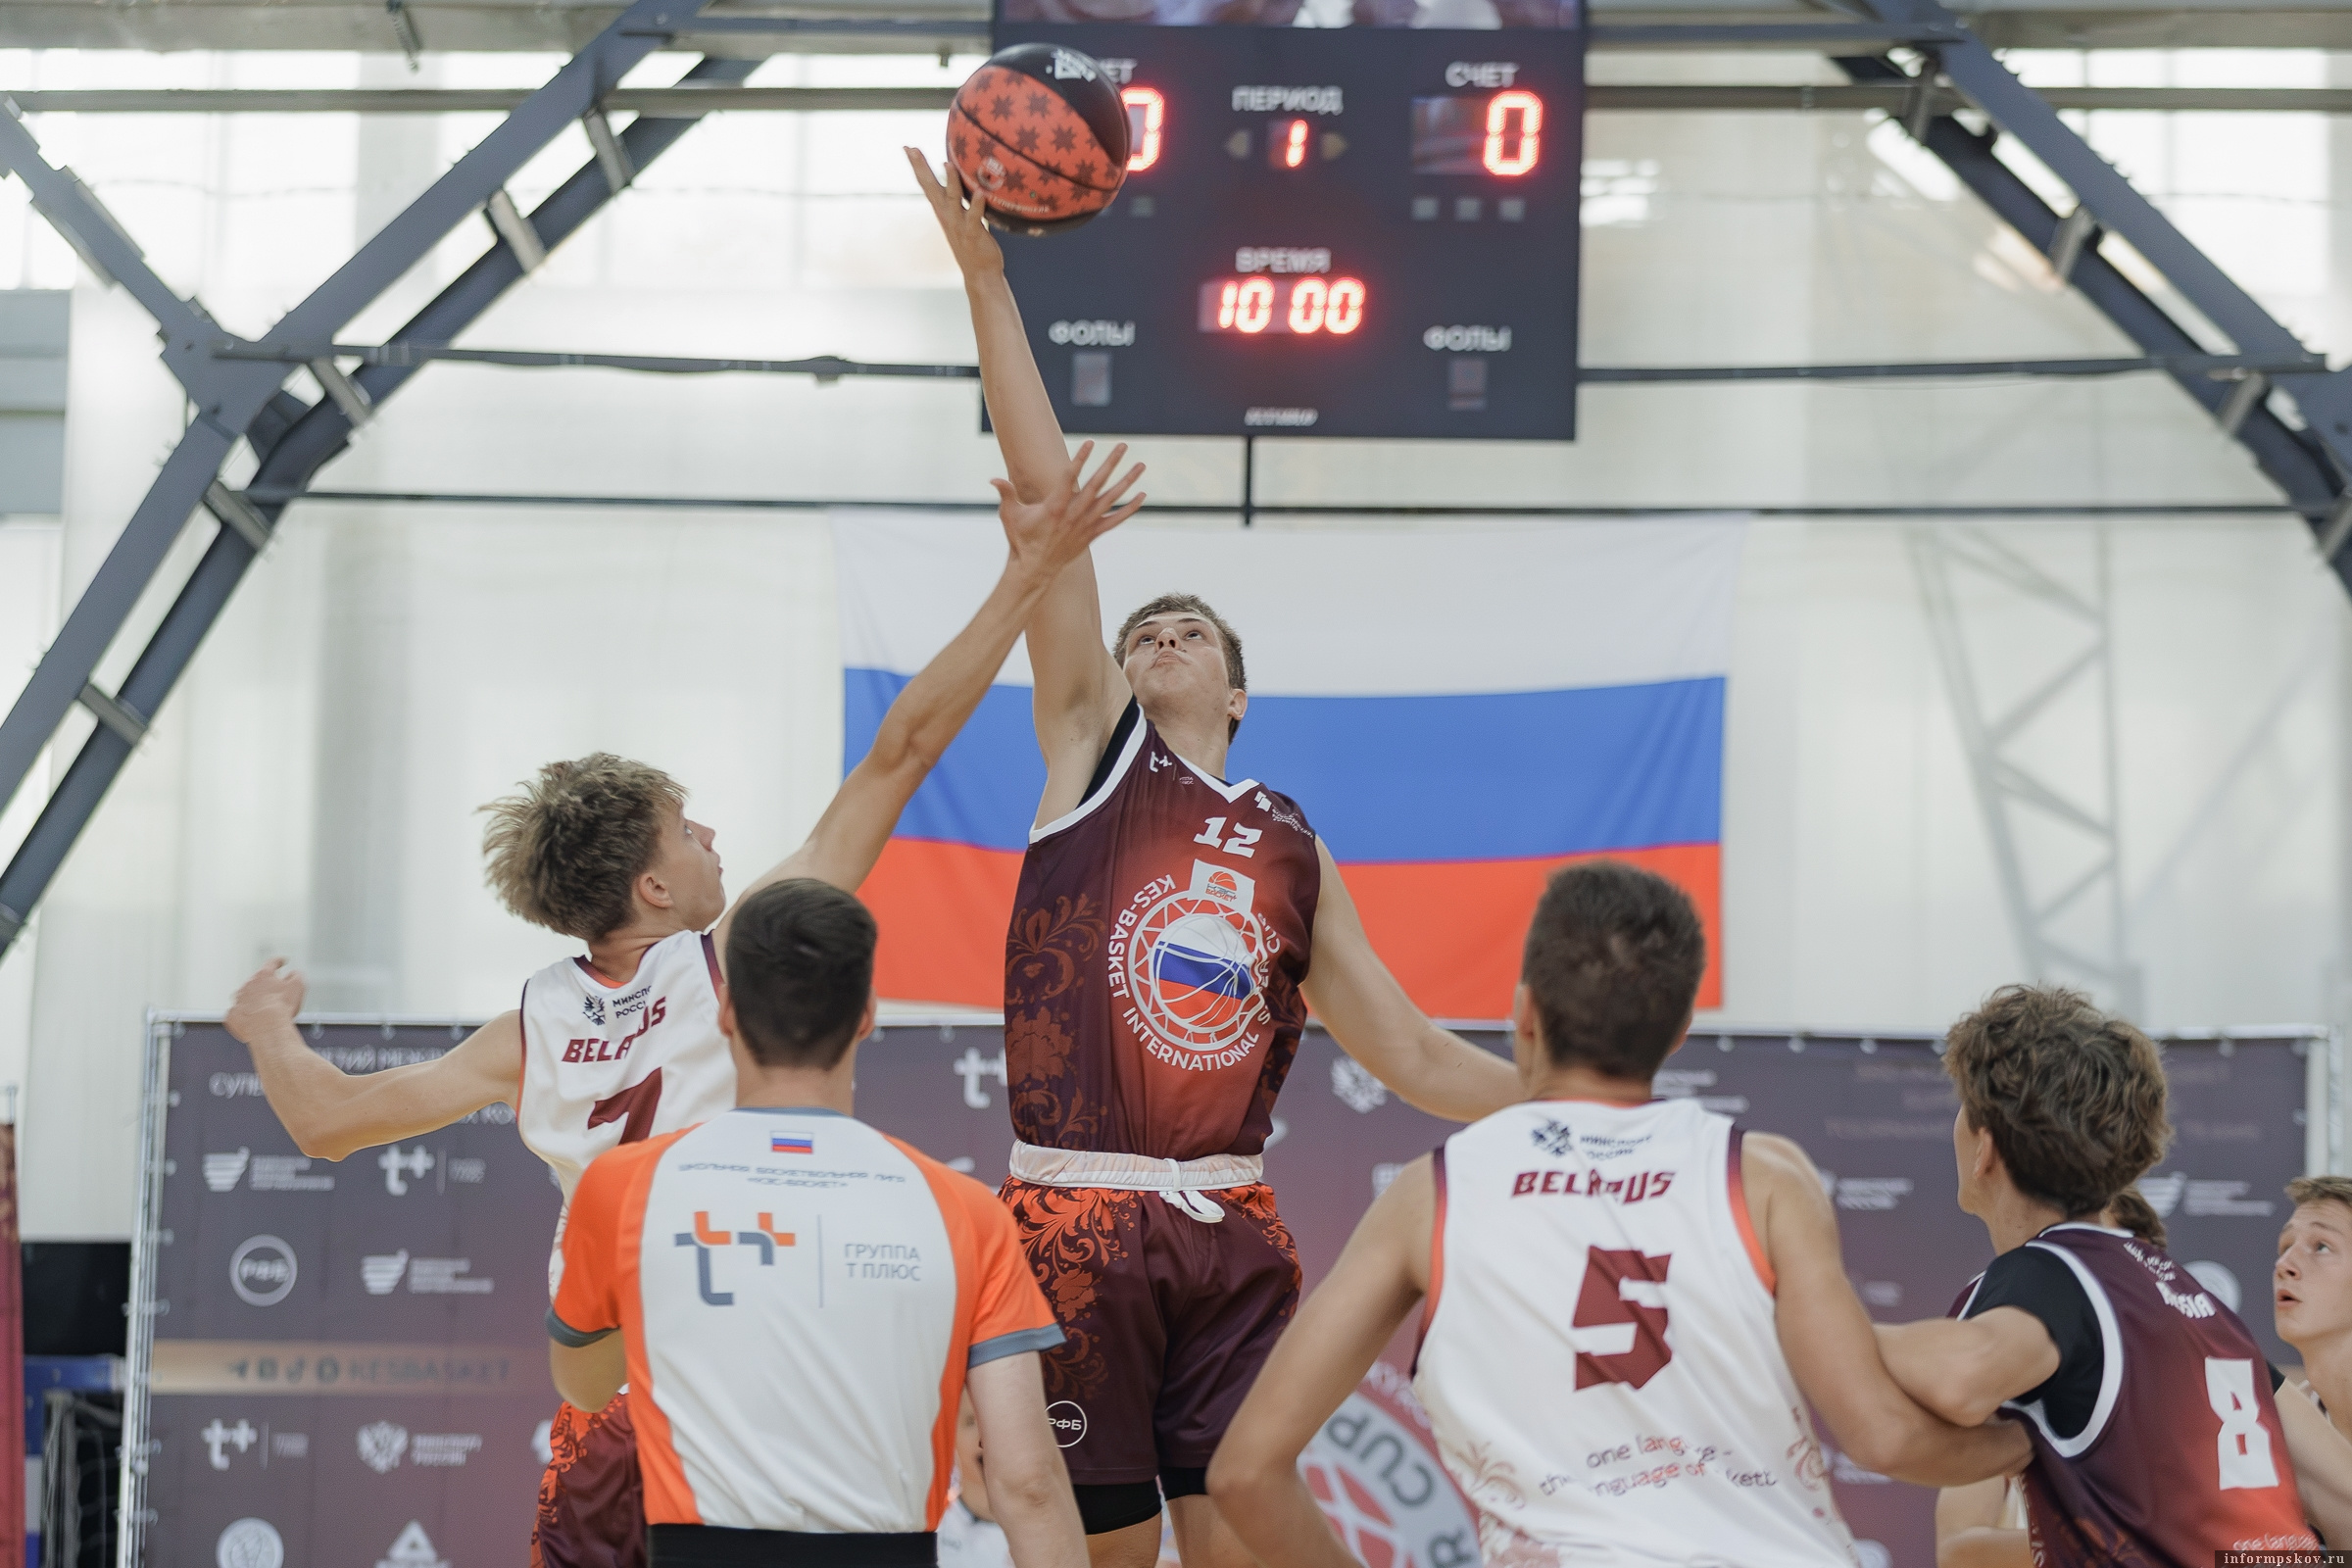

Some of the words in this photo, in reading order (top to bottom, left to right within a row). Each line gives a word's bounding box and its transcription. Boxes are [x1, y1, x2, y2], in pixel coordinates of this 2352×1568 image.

[1446, 62, 1518, 87] СЧЕТ
[1232, 85, 1344, 115] ПЕРИОД
[1286, 120, 1308, 167] 1
[1483, 90, 1543, 176] 0
[1236, 247, 1331, 273] ВРЕМЯ
[1049, 319, 1136, 346] ФОЛЫ
[1423, 324, 1512, 351] ФОЛЫ
[1193, 816, 1263, 858] 12
[562, 997, 666, 1063] BELAUS
[1122, 1006, 1260, 1072] INTERNATIONAL
[587, 1066, 663, 1146] 7
[845, 1243, 921, 1262] ГРУППА
[847, 1262, 858, 1278] Т
[861, 1262, 922, 1281] ПЛЮС
[1572, 1245, 1673, 1392] 5
[2205, 1357, 2278, 1491] 8
[1326, 1411, 1435, 1508] CUP
[1587, 1444, 1632, 1469] one
[1592, 1461, 1680, 1497] nguage
